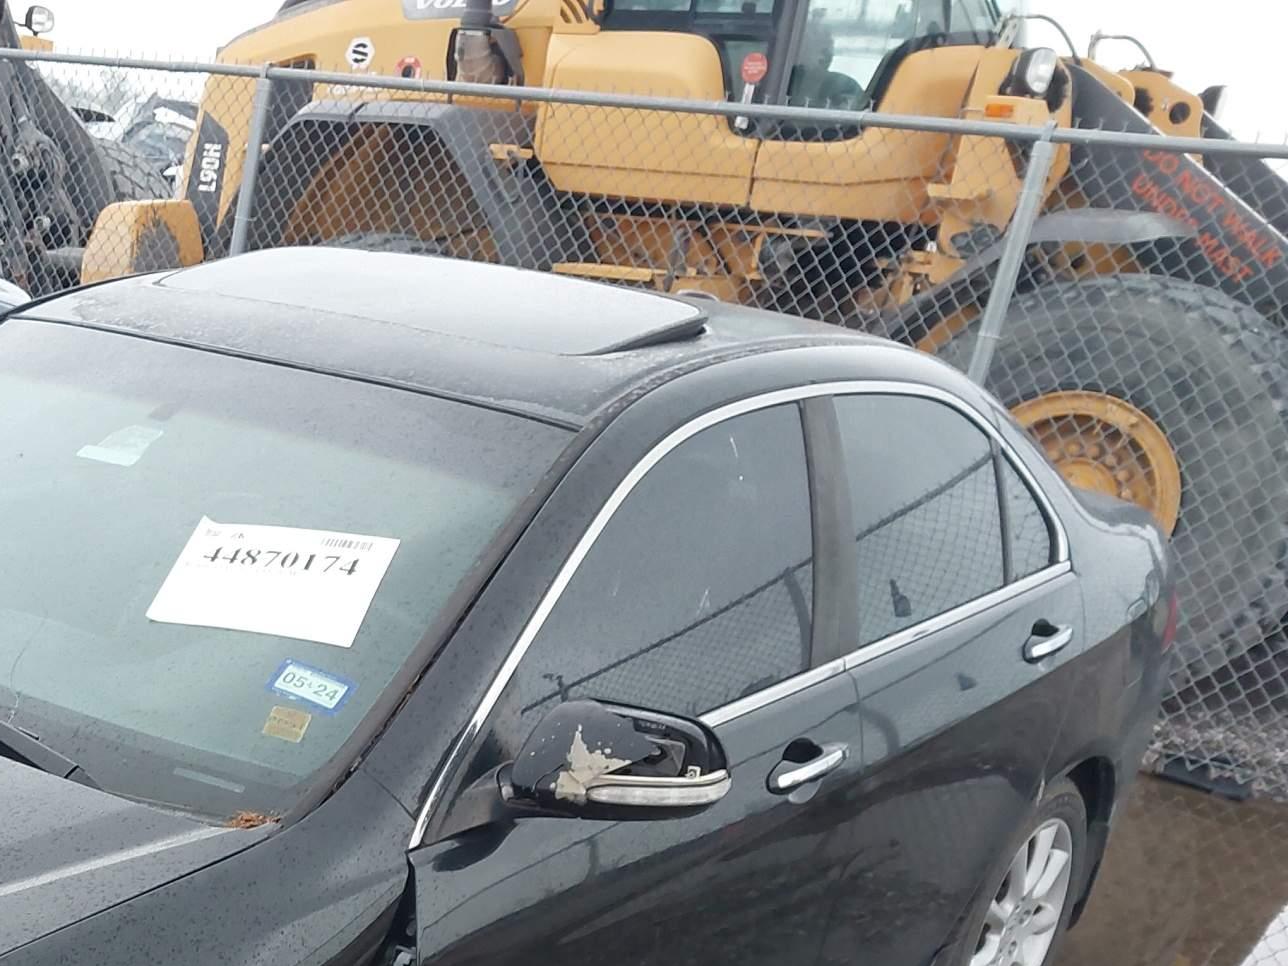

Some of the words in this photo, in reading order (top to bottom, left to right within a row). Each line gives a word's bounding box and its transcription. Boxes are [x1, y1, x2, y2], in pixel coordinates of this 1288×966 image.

[197, 143, 223, 193] L90H
[1176, 169, 1225, 214] NOT
[1223, 210, 1283, 270] WALK
[1195, 231, 1255, 283] MAST
[203, 546, 360, 576] 44870174
